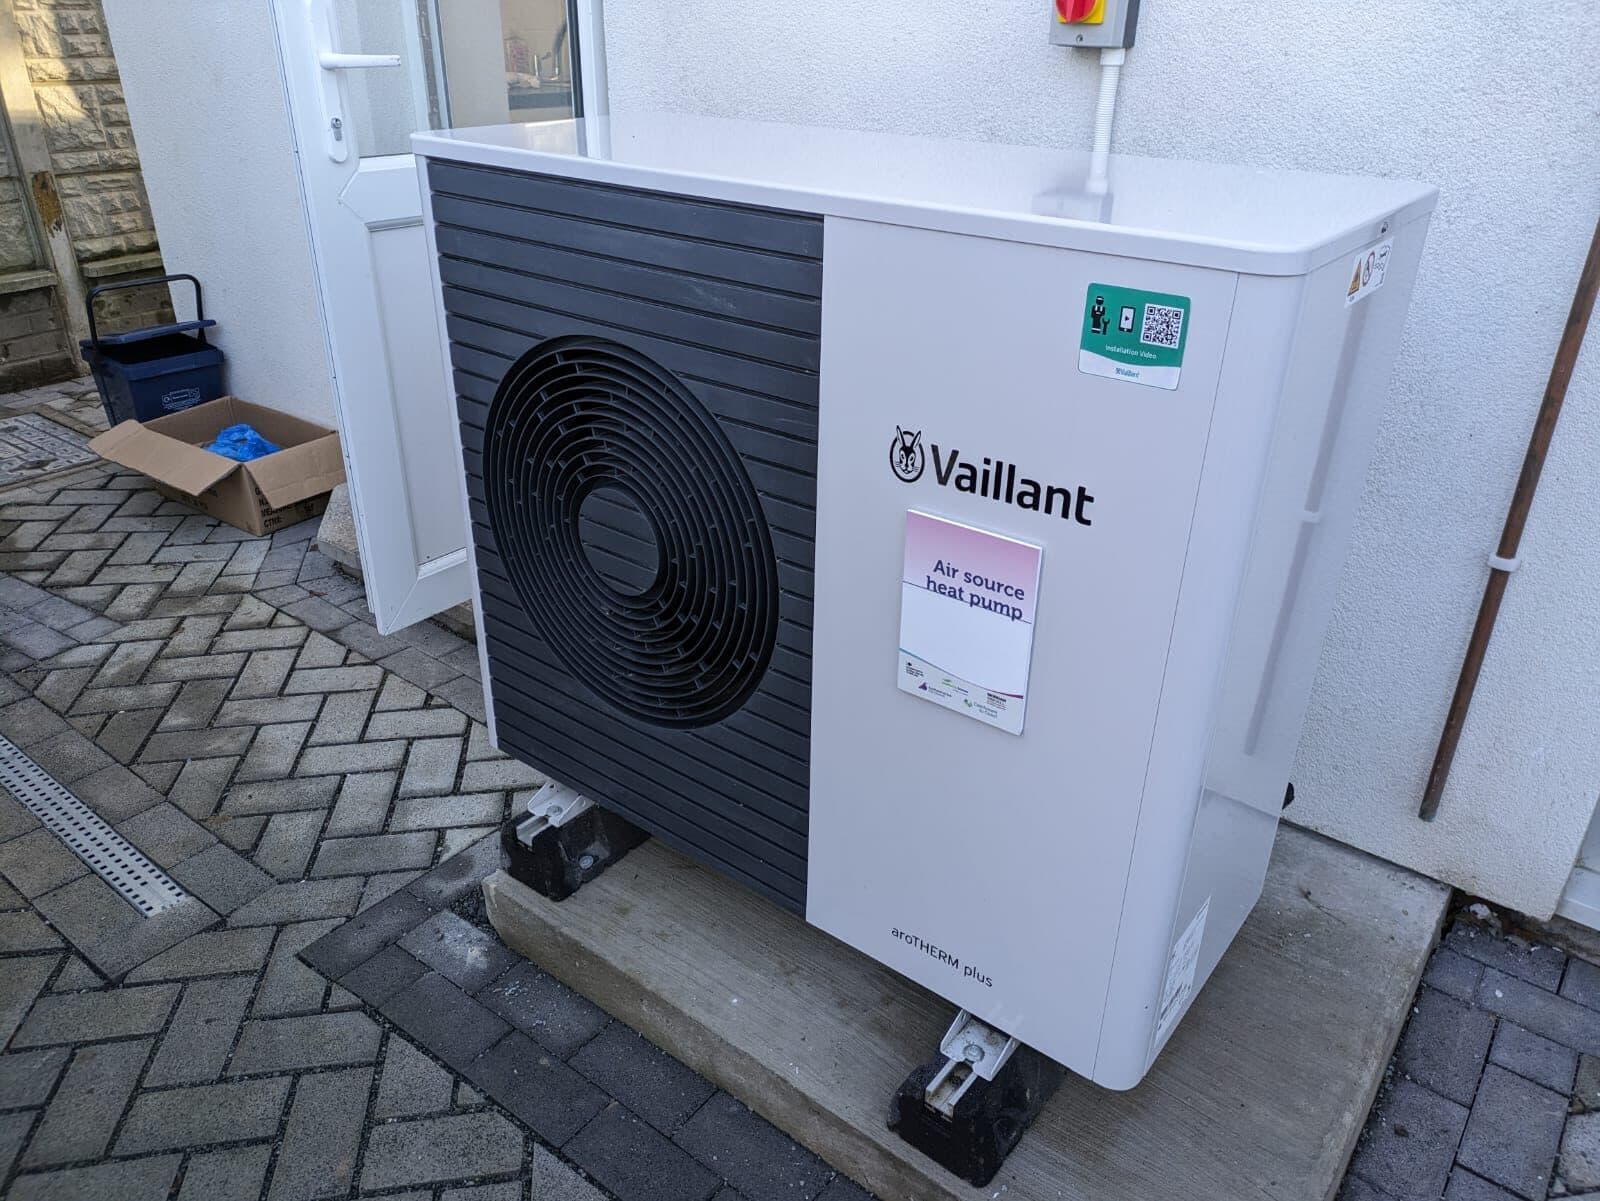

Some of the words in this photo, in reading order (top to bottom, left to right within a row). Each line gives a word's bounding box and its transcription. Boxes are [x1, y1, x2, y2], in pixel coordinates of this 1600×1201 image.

[1105, 344, 1139, 356] Installation
[1140, 351, 1157, 360] Video
[930, 443, 1095, 526] Vaillant
[926, 575, 964, 602] heat
[969, 592, 1023, 622] pump
[933, 559, 959, 579] Air
[963, 571, 1025, 601] source
[891, 927, 959, 969] aroTHERM
[963, 966, 993, 988] plus
